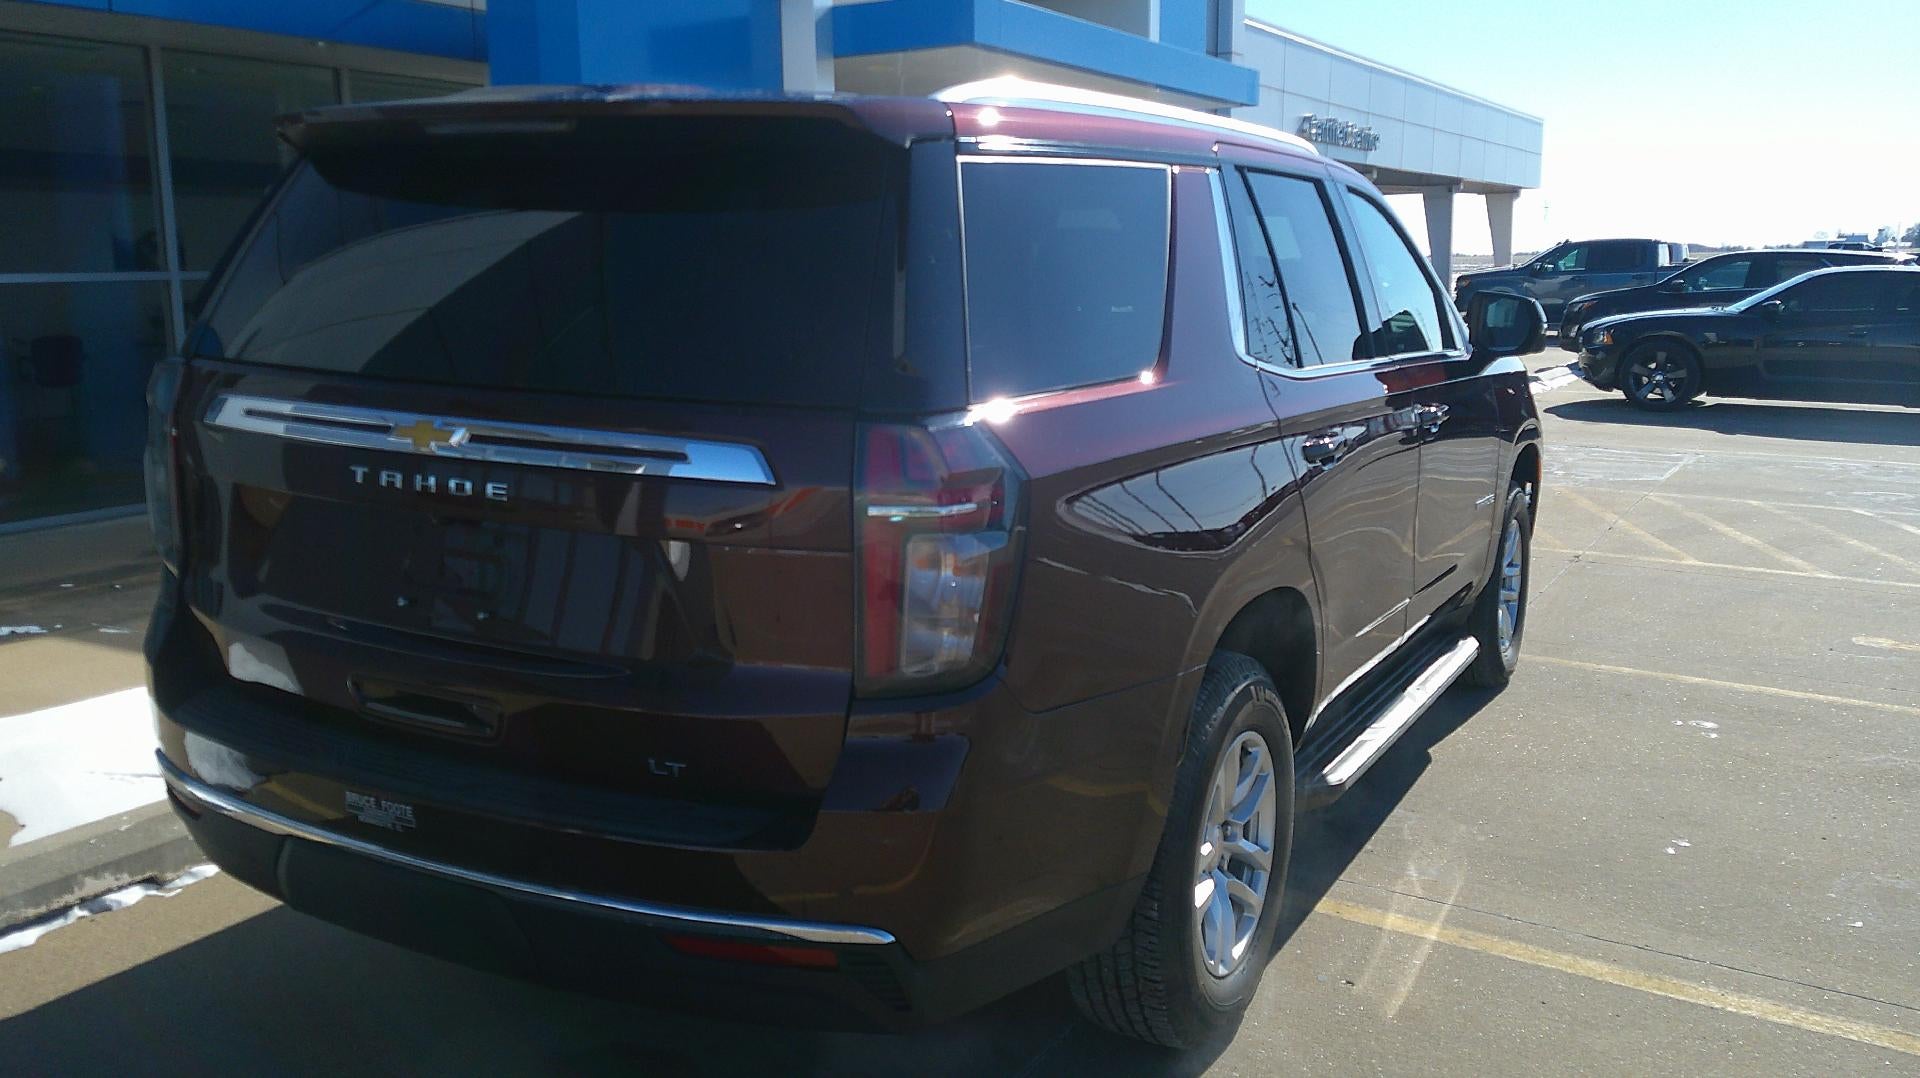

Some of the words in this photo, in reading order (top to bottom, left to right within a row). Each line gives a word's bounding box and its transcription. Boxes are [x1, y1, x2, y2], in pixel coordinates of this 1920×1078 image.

[349, 465, 509, 502] TAHOE
[647, 757, 688, 778] LT
[345, 791, 377, 809] BRUCE
[381, 800, 414, 817] FOOTE
